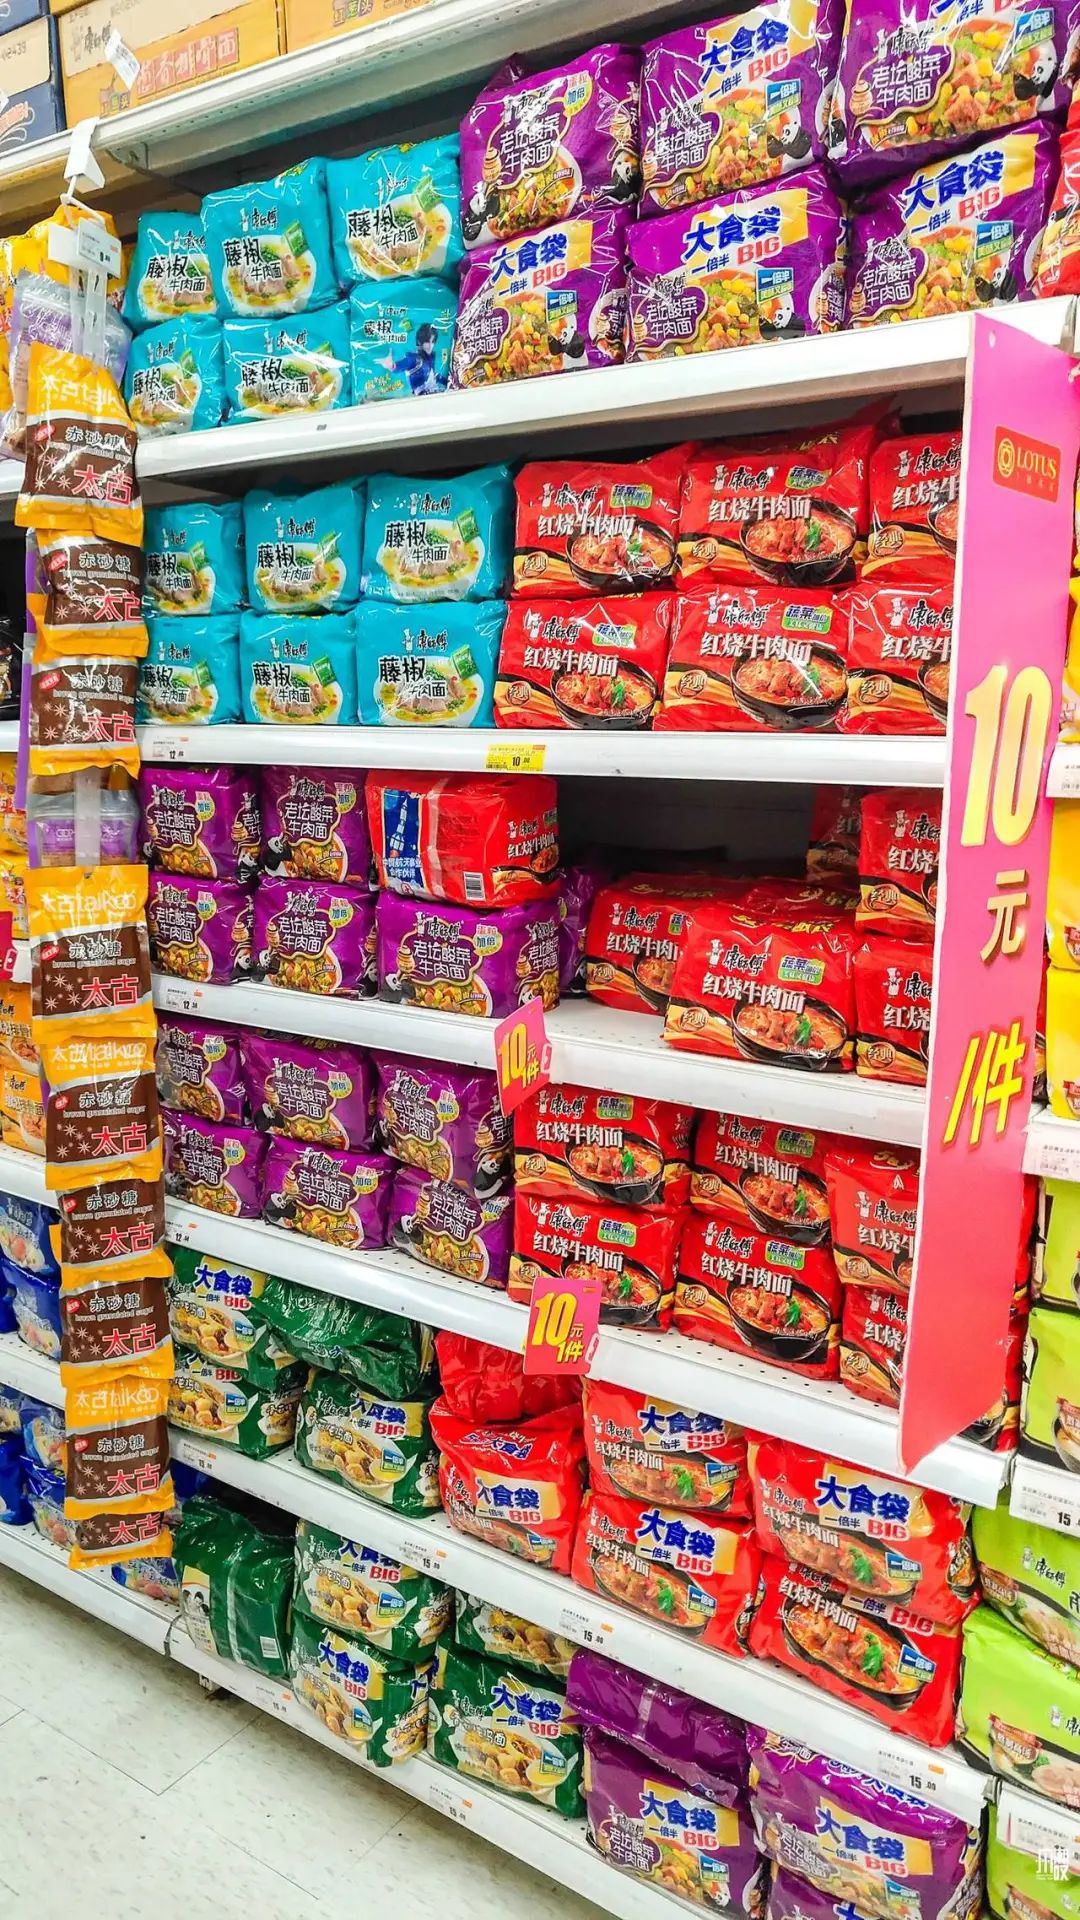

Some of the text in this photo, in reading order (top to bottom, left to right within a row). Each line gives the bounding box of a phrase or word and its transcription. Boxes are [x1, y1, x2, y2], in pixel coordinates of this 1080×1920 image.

[700, 19, 789, 83] 大食袋
[749, 48, 788, 81] BIG
[872, 53, 941, 88] 老坛酸菜
[709, 73, 742, 98] 一倍半
[877, 80, 931, 108] 牛肉面
[505, 139, 552, 172] 牛肉面
[661, 148, 704, 172] 牛肉面
[902, 151, 1004, 220] 大食袋
[959, 186, 1000, 220] BIG
[348, 204, 397, 236] 藤椒
[911, 210, 951, 233] 一倍半
[381, 225, 417, 249] 牛肉面
[684, 206, 781, 260] 大食袋
[222, 239, 260, 267] 藤椒
[491, 233, 567, 282] 大食袋
[737, 237, 779, 264] BIG
[146, 255, 186, 277] 藤椒
[251, 260, 280, 280] 牛肉面
[533, 263, 566, 287] BIG
[692, 254, 730, 273] 一倍半
[170, 277, 205, 292] 牛肉面
[499, 278, 527, 296] 一倍半
[867, 282, 911, 305] 牛肉面
[364, 322, 392, 336] 藤椒
[651, 318, 692, 339] 牛肉面
[133, 369, 161, 394] 藤椒
[268, 377, 309, 395] 牛肉面
[1017, 448, 1056, 480] LOTUS
[420, 494, 452, 513] 康师傅
[709, 494, 812, 521] 红烧牛肉面
[385, 521, 427, 548] 藤椒
[537, 514, 636, 540] 红烧牛肉面
[876, 530, 902, 550] 经典
[79, 552, 130, 572] 赤砂糖
[146, 554, 177, 576] 藤椒
[257, 544, 295, 568] 藤椒
[411, 546, 448, 562] 牛肉面
[165, 576, 192, 589] 牛肉面
[280, 568, 312, 581] 牛肉面
[542, 617, 581, 643] 康师傅
[700, 632, 812, 661] 红烧牛肉面
[881, 634, 952, 662] 红烧牛
[379, 657, 425, 682] 藤椒
[523, 646, 619, 678] 红烧牛肉面
[143, 664, 172, 688] 藤椒
[252, 663, 292, 687] 藤椒
[160, 689, 188, 703] 牛肉面
[278, 688, 310, 703] 牛肉面
[512, 756, 521, 766] 10
[961, 664, 1053, 848] 10
[155, 810, 196, 830] 老坛酸菜
[284, 802, 333, 821] 老坛酸菜
[160, 828, 194, 844] 牛肉面
[288, 820, 328, 839] 牛肉面
[390, 868, 416, 879] 合作伙伴
[155, 907, 196, 927] 老坛酸菜
[278, 916, 327, 936] 老坛酸菜
[623, 906, 661, 933] 康师傅
[980, 868, 1027, 962] 元
[160, 925, 194, 942] 牛肉面
[283, 933, 322, 952] 牛肉面
[413, 940, 471, 965] 老坛酸菜
[723, 944, 768, 974] 康师傅
[418, 960, 466, 980] 牛肉面
[81, 974, 139, 1008] 太古
[702, 972, 806, 1014] 红烧牛肉面
[184, 1001, 189, 1009] 12
[499, 1023, 527, 1089] 10
[528, 1044, 536, 1059] 元
[868, 1044, 896, 1059] 经典
[276, 1082, 328, 1105] 老坛酸菜
[63, 1109, 86, 1118] brown
[127, 1104, 146, 1116] sugar
[282, 1098, 323, 1118] 牛肉面
[551, 1092, 585, 1120] 康师傅
[92, 1122, 148, 1157] 太古
[536, 1120, 623, 1148] 红烧牛肉面
[729, 1117, 764, 1147] 康师傅
[182, 1148, 222, 1172] 老坛酸菜
[715, 1142, 798, 1185] 红烧牛肉面
[298, 1170, 350, 1199] 老坛酸菜
[303, 1186, 343, 1210] 牛肉面
[432, 1191, 477, 1227] 老坛酸菜
[72, 1211, 94, 1221] brown
[133, 1204, 154, 1216] sugar
[432, 1209, 466, 1240] 牛肉面
[101, 1222, 155, 1258] 太古
[176, 1233, 182, 1242] 12
[718, 1227, 755, 1258] 康师傅
[533, 1231, 623, 1272] 红烧牛肉面
[196, 1264, 253, 1296] 大食袋
[702, 1253, 793, 1296] 红烧牛肉面
[847, 1261, 870, 1275] 经典
[136, 1306, 154, 1317] sugar
[532, 1292, 577, 1346] 10
[102, 1323, 156, 1358] 太古
[570, 1323, 584, 1337] 元
[557, 1340, 583, 1363] 1件
[845, 1356, 870, 1374] 经典
[374, 1422, 405, 1438] BIG
[98, 1435, 145, 1454] 赤砂糖
[594, 1440, 664, 1471] 红烧牛肉面
[107, 1463, 160, 1496] 太古
[817, 1475, 910, 1523] 大食袋
[508, 1509, 541, 1523] BIG
[762, 1502, 840, 1548] 红烧牛肉面
[824, 1515, 860, 1528] 一倍半
[1057, 1512, 1071, 1526] 15
[637, 1510, 716, 1559] 大食袋
[867, 1520, 908, 1539] BIG
[422, 1557, 431, 1569] 15
[586, 1530, 650, 1578] 红烧牛肉面
[640, 1547, 672, 1561] 一倍半
[674, 1554, 713, 1574] BIG
[369, 1566, 400, 1582] BIG
[778, 1577, 860, 1633] 红烧牛肉面
[890, 1606, 935, 1635] BIG
[583, 1630, 593, 1642] 15
[319, 1641, 370, 1684] 大食袋
[344, 1680, 366, 1699] BIG
[528, 1721, 559, 1738] BIG
[909, 1775, 936, 1791] 15 .00
[639, 1791, 717, 1832] 大食袋
[649, 1826, 679, 1839] 一倍半
[683, 1830, 718, 1850] BIG
[613, 1844, 650, 1872] 牛肉面
[864, 1856, 907, 1876] BIG
